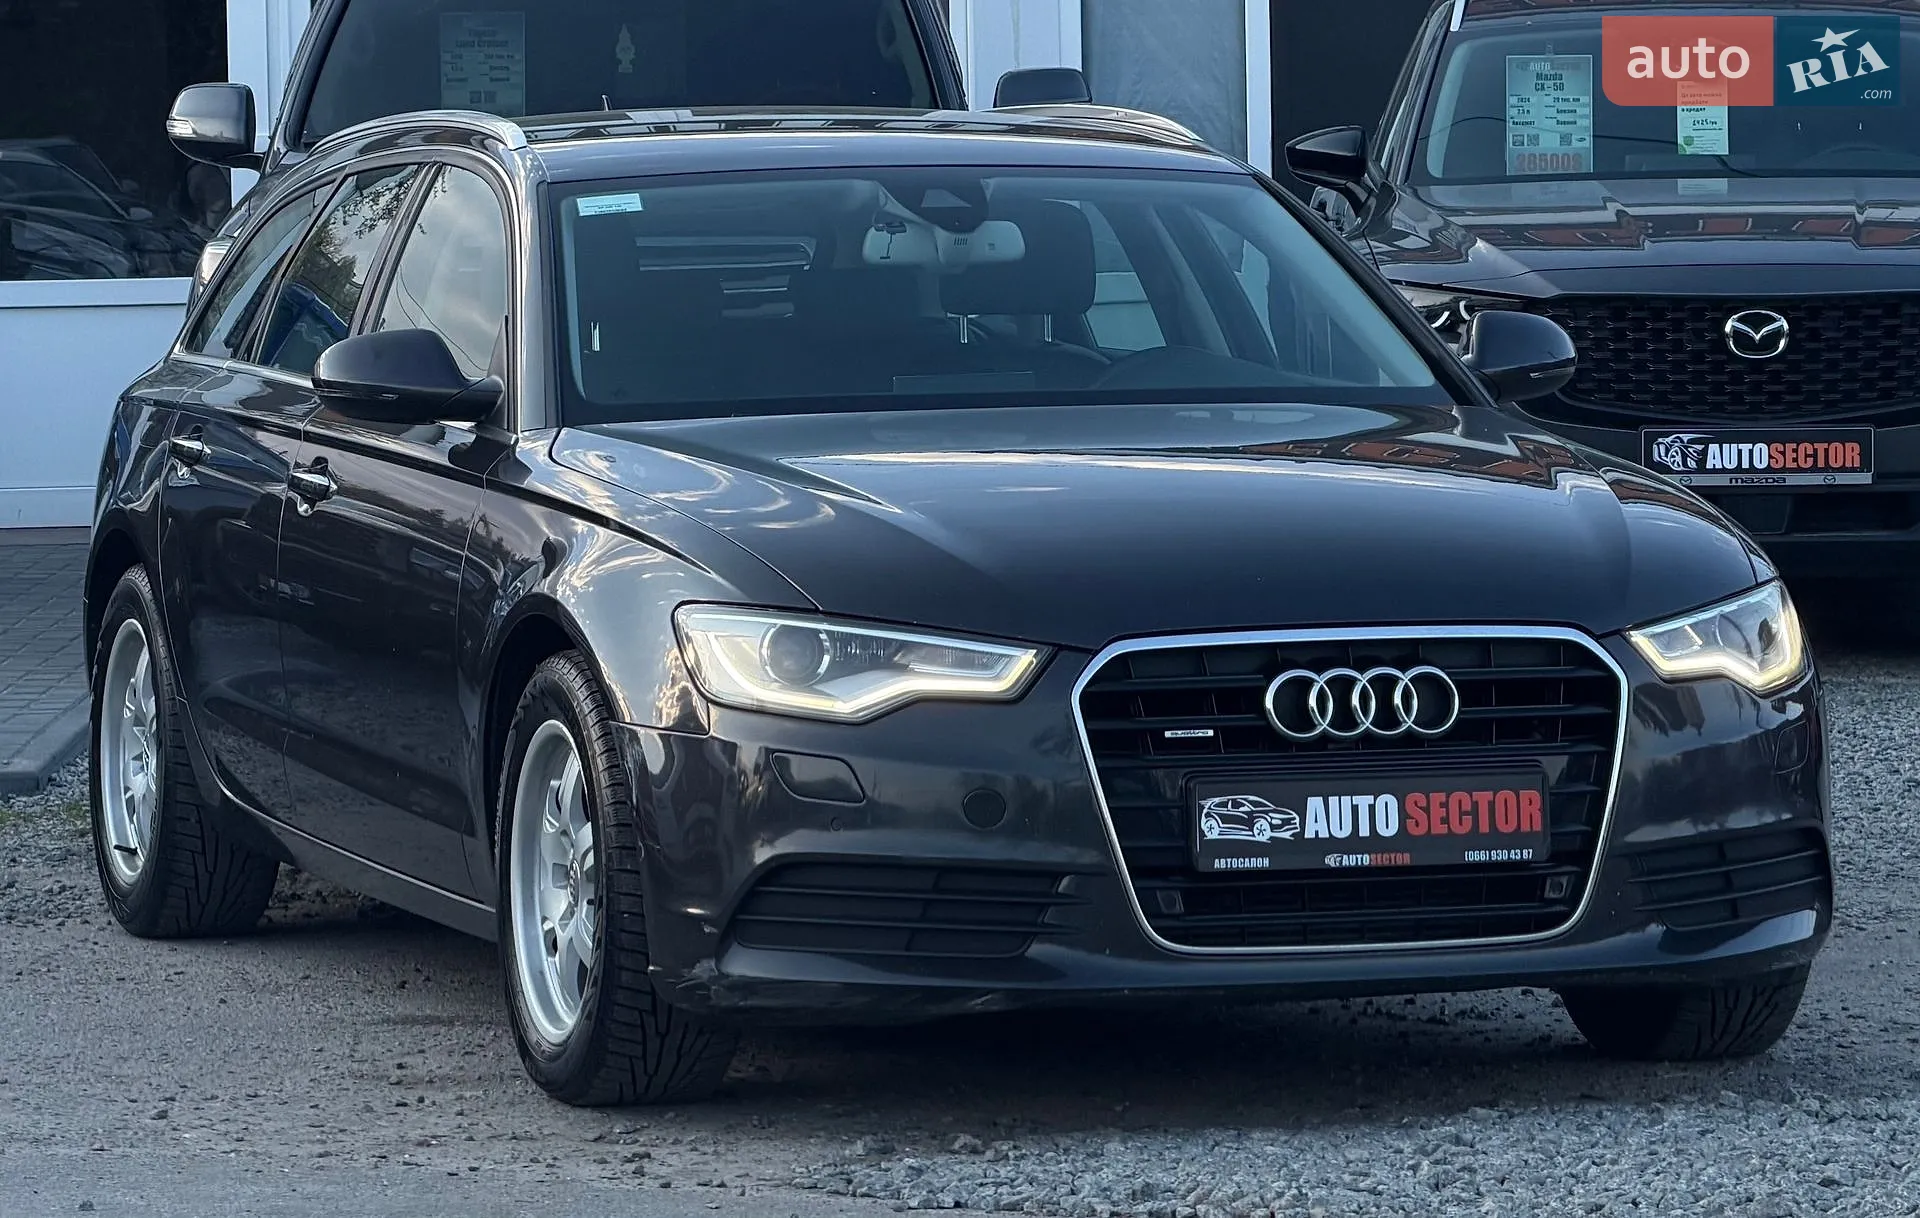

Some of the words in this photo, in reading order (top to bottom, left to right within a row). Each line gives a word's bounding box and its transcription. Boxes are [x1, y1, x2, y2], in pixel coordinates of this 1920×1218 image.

[1535, 72, 1564, 81] Mazda
[1706, 442, 1860, 469] AUTOSECTOR
[1304, 793, 1399, 839] AUTO
[1404, 789, 1542, 836] SECTOR
[1465, 851, 1490, 862] (066)
[1491, 850, 1508, 862] 930
[1510, 849, 1521, 860] 43
[1523, 849, 1534, 860] 87
[1214, 857, 1270, 869] АВТОСАЛОН
